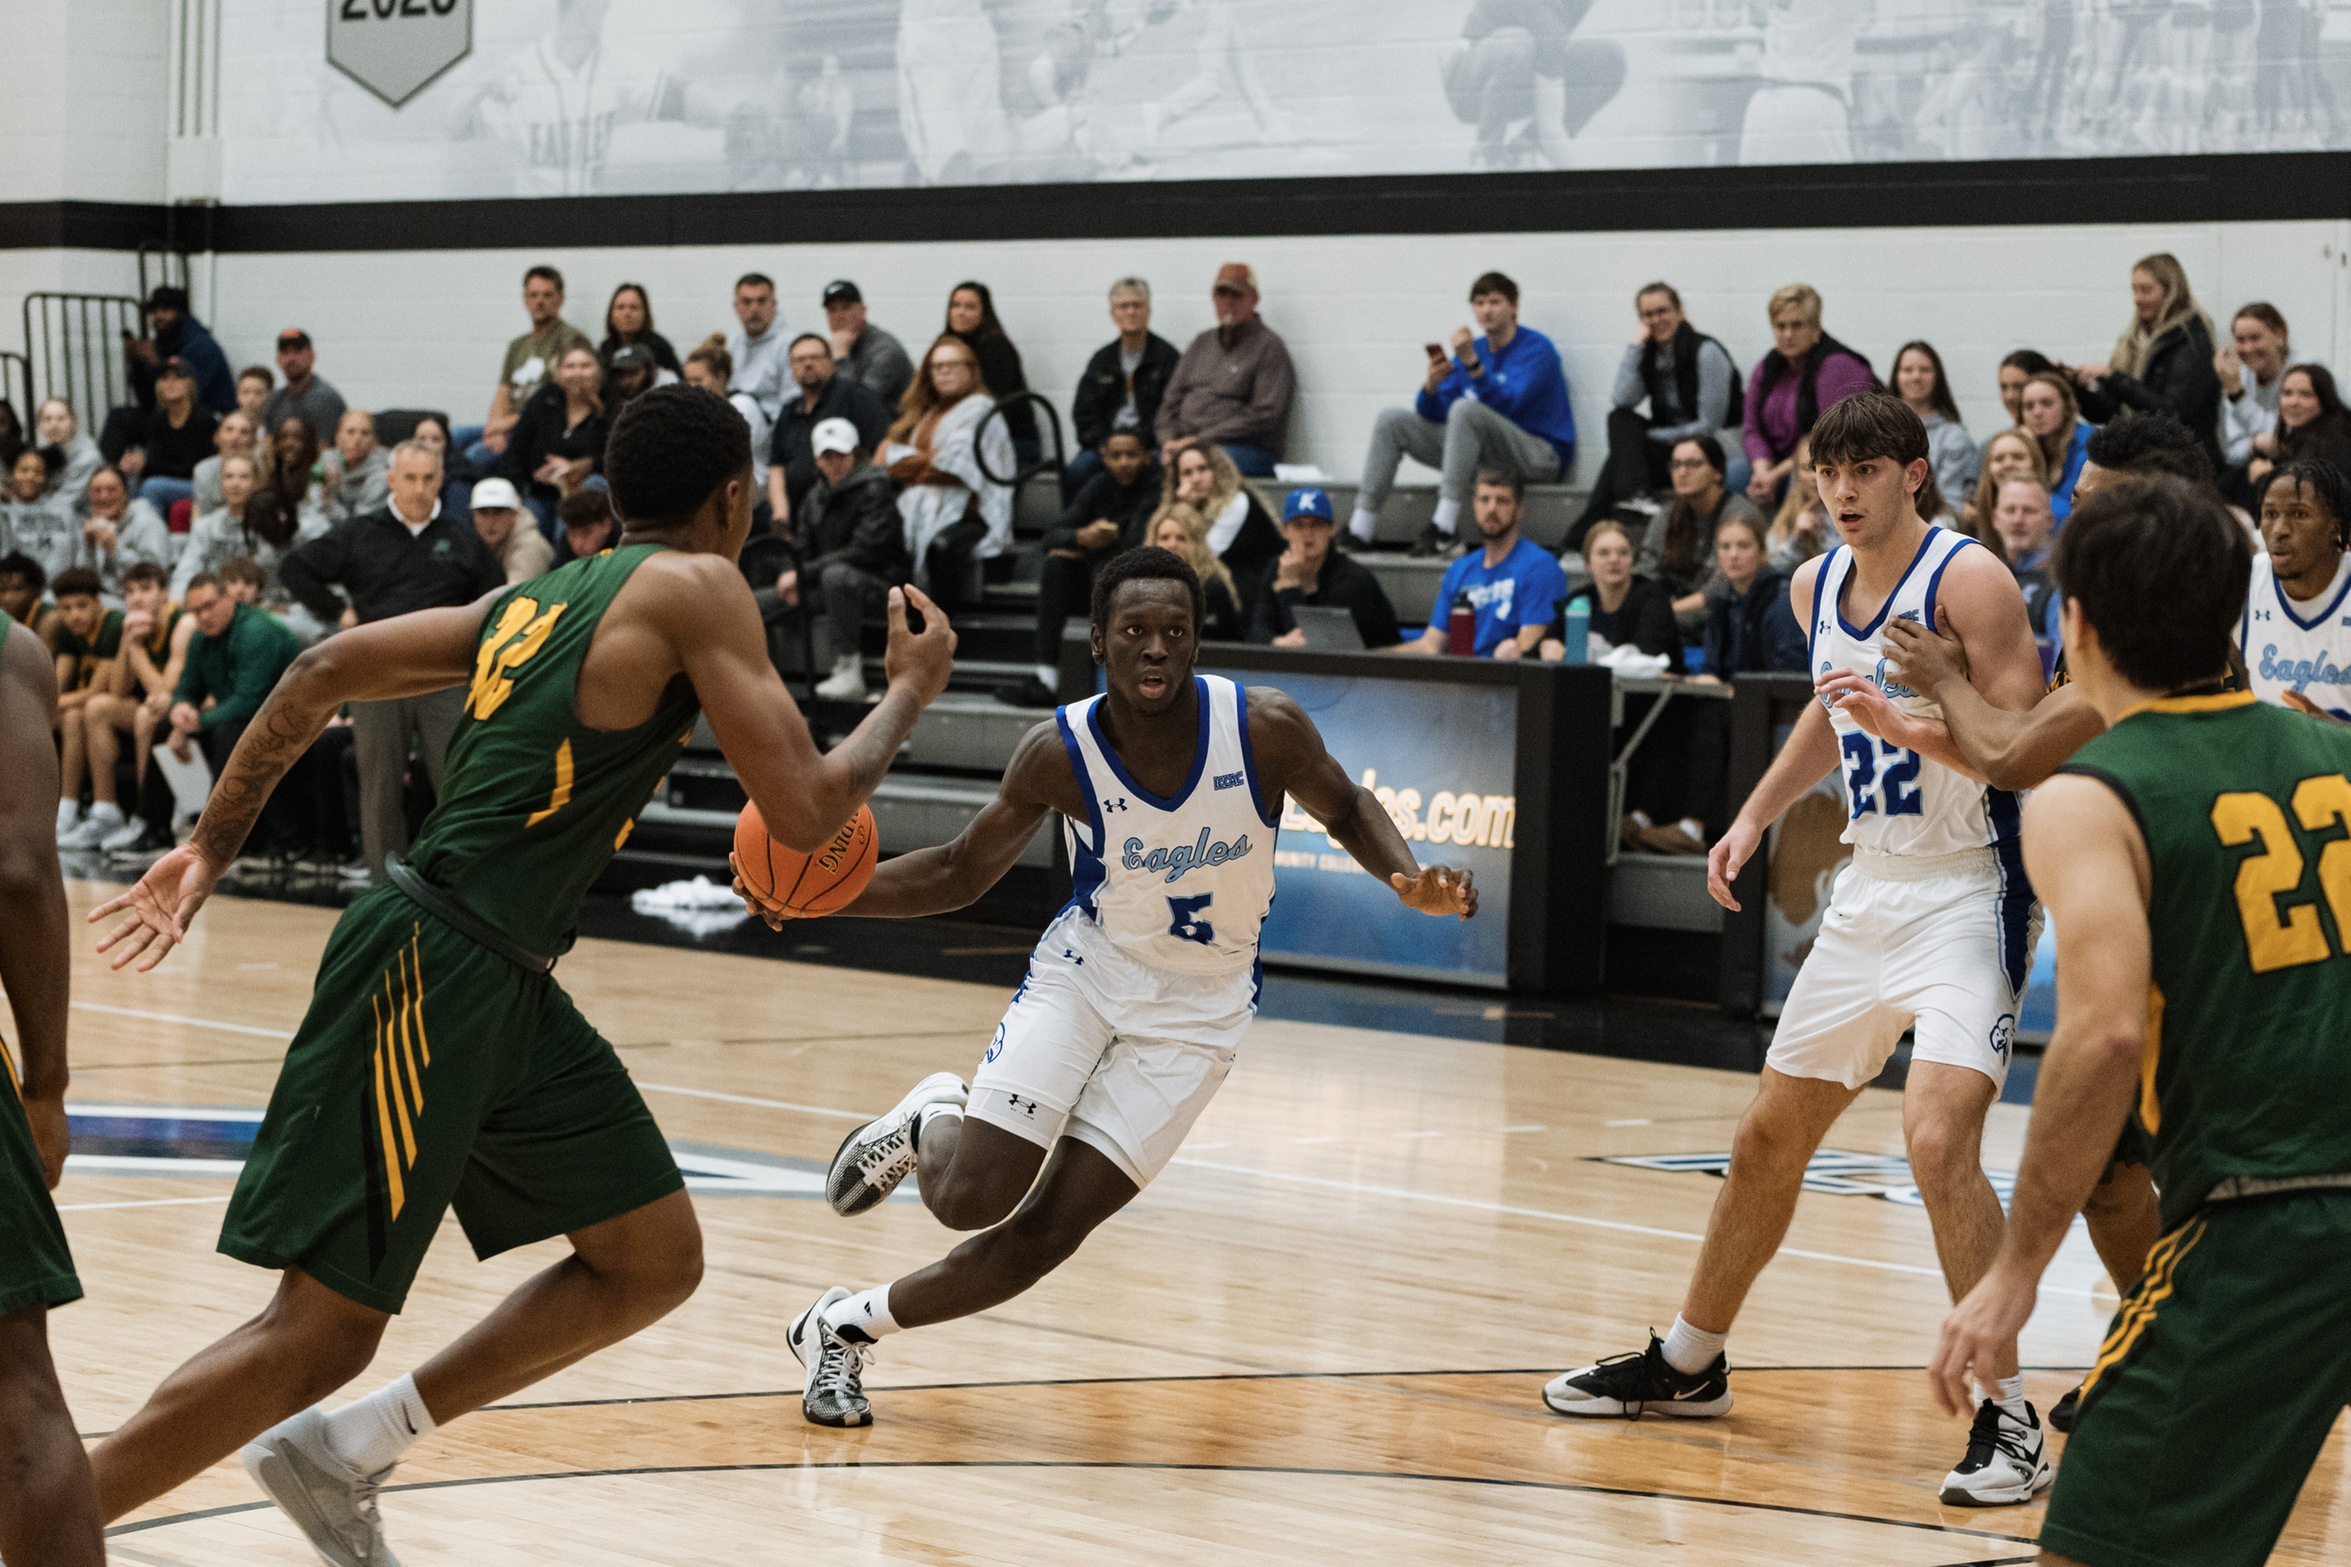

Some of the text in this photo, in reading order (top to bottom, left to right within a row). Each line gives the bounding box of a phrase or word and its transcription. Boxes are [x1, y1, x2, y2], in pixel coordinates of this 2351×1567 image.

[1298, 491, 1317, 510] K
[1841, 730, 1923, 821] 22
[1122, 827, 1253, 883] Eagles
[1165, 892, 1215, 945] 5
